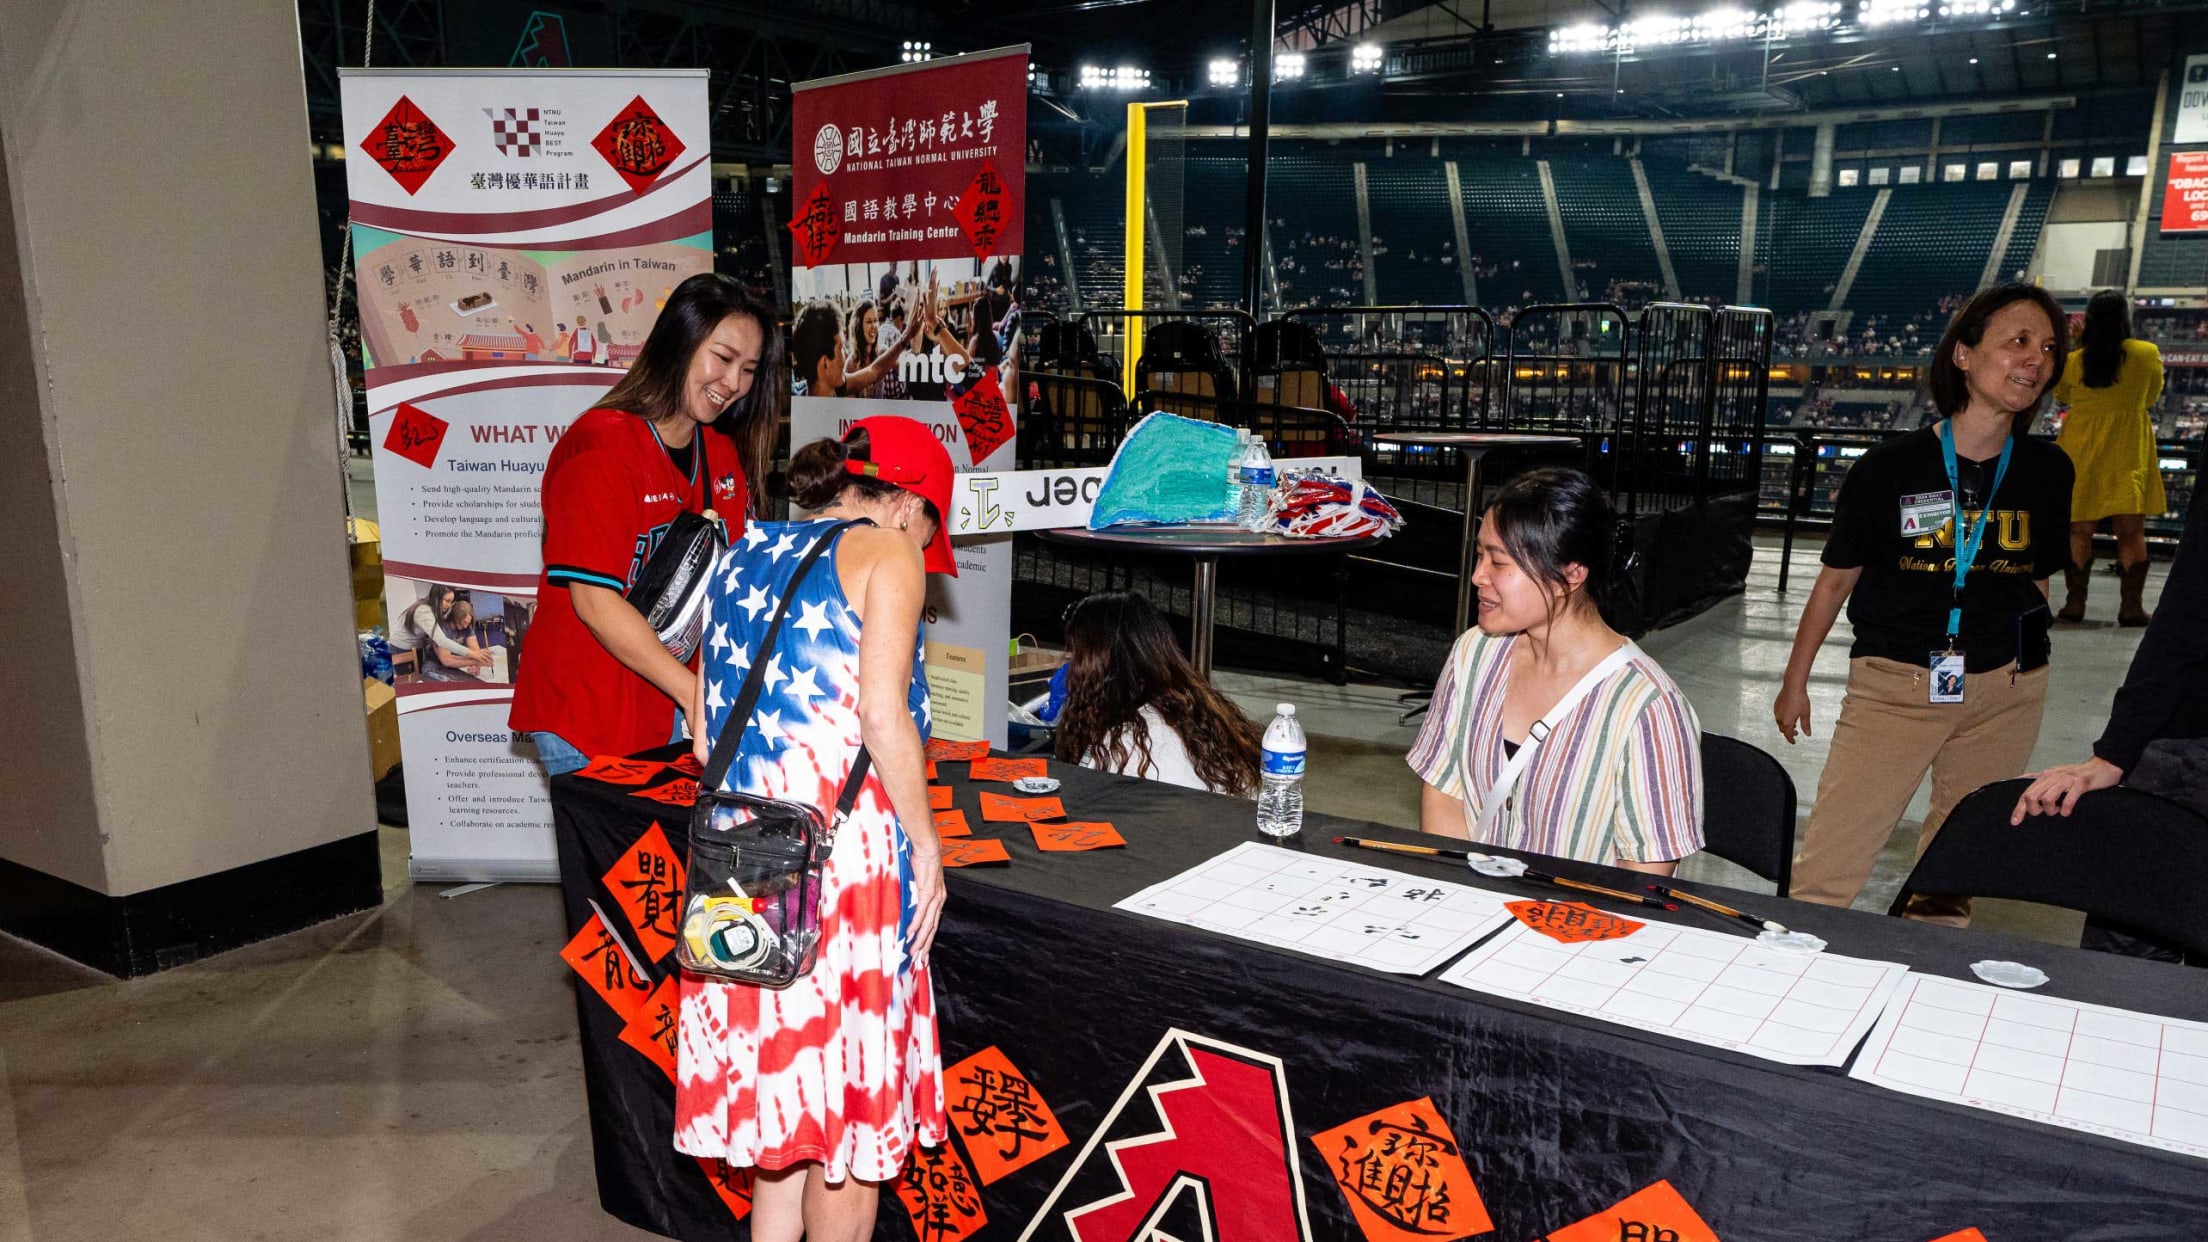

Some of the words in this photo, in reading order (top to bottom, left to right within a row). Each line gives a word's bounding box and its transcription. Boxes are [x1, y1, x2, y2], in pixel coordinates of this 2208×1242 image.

[847, 100, 998, 158] 國立臺灣師範大學
[847, 161, 883, 172] NATIONAL
[886, 157, 912, 169] TAIWAN
[915, 152, 947, 165] NORMAL
[951, 146, 998, 162] UNIVERSITY
[471, 173, 589, 190] 臺灣優華語計畫
[844, 191, 960, 222] 國語教學中心
[844, 228, 886, 244] Mandarin
[888, 227, 923, 241] Training
[927, 226, 959, 239] Center
[561, 262, 615, 285] Mandarin
[619, 259, 630, 270] in
[633, 258, 676, 272] Taiwan
[899, 345, 966, 384] mtc
[470, 425, 537, 443] WHAT
[544, 425, 572, 443] W
[447, 459, 496, 472] Taiwan
[501, 459, 545, 474] Huayu
[421, 485, 441, 493] Send
[443, 485, 490, 495] high-quality
[493, 485, 531, 493] Mandarin
[423, 500, 453, 508] Provide
[456, 500, 504, 510] scholarships
[506, 500, 518, 508] for
[424, 515, 457, 525] Develop
[459, 515, 493, 525] language
[495, 515, 509, 523] and
[511, 515, 541, 523] cultural
[955, 560, 987, 572] cademic
[446, 731, 508, 743] Overseas
[445, 756, 477, 764] Enhance
[479, 756, 525, 764] certification
[446, 770, 476, 778] Provide
[479, 770, 525, 780] professional
[448, 795, 468, 803] Offer
[472, 795, 486, 803] and
[489, 795, 525, 803] introduce
[449, 806, 481, 815] learning
[482, 807, 520, 815] resources.
[450, 820, 493, 828] Collaborate
[507, 820, 542, 828] academic
